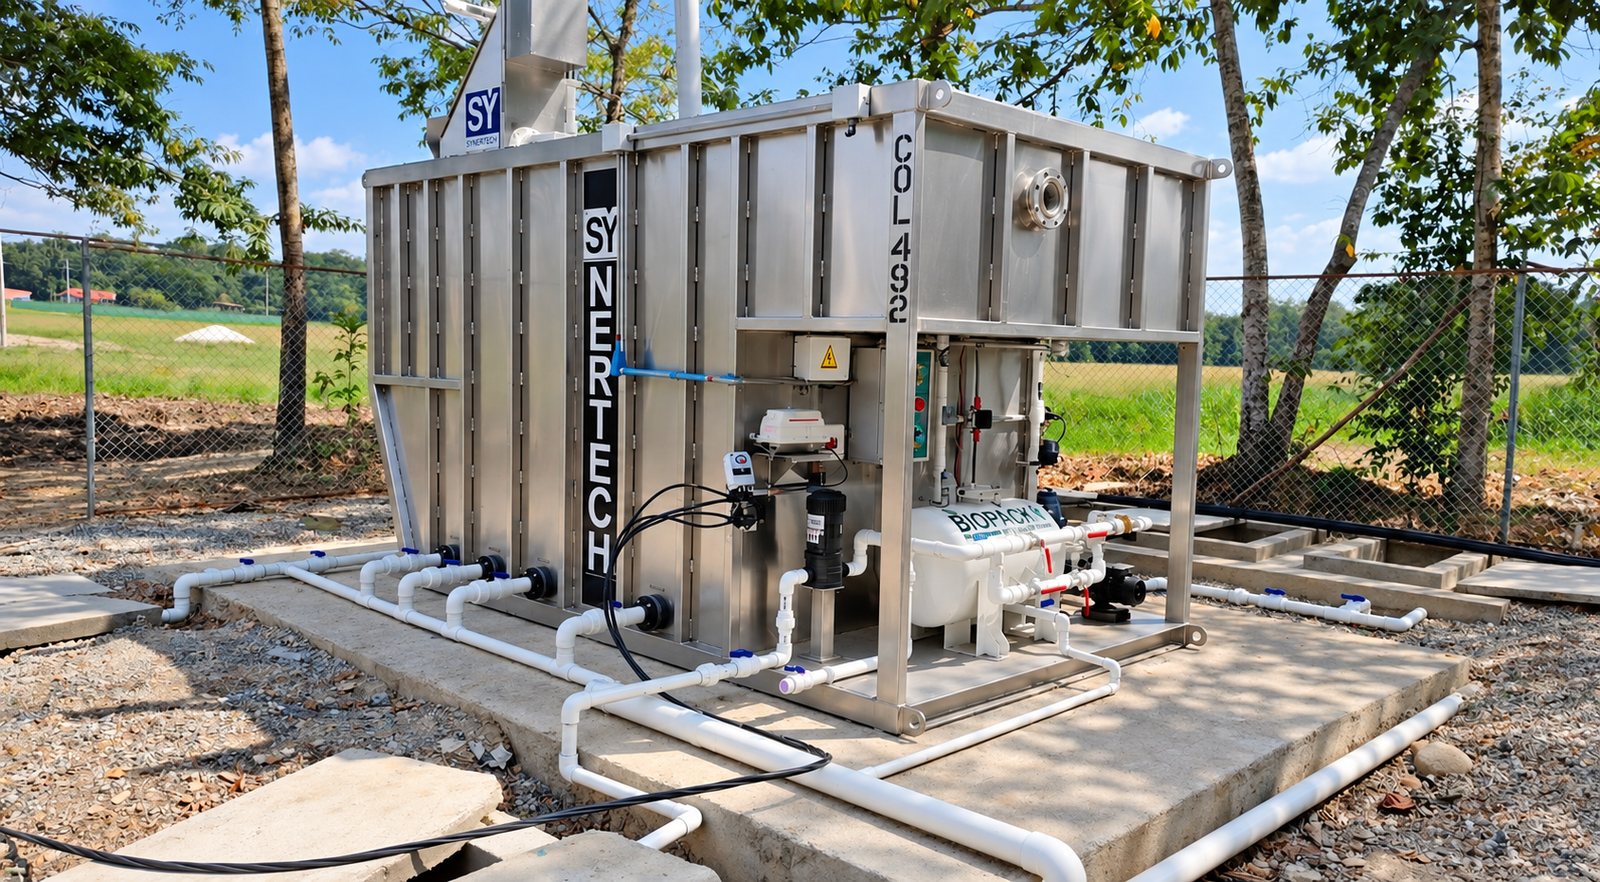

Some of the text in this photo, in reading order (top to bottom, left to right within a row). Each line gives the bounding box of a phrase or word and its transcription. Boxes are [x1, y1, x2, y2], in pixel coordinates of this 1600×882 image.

[467, 92, 499, 132] SY
[889, 134, 913, 323] COL 492
[948, 507, 1035, 533] BIOPACK
